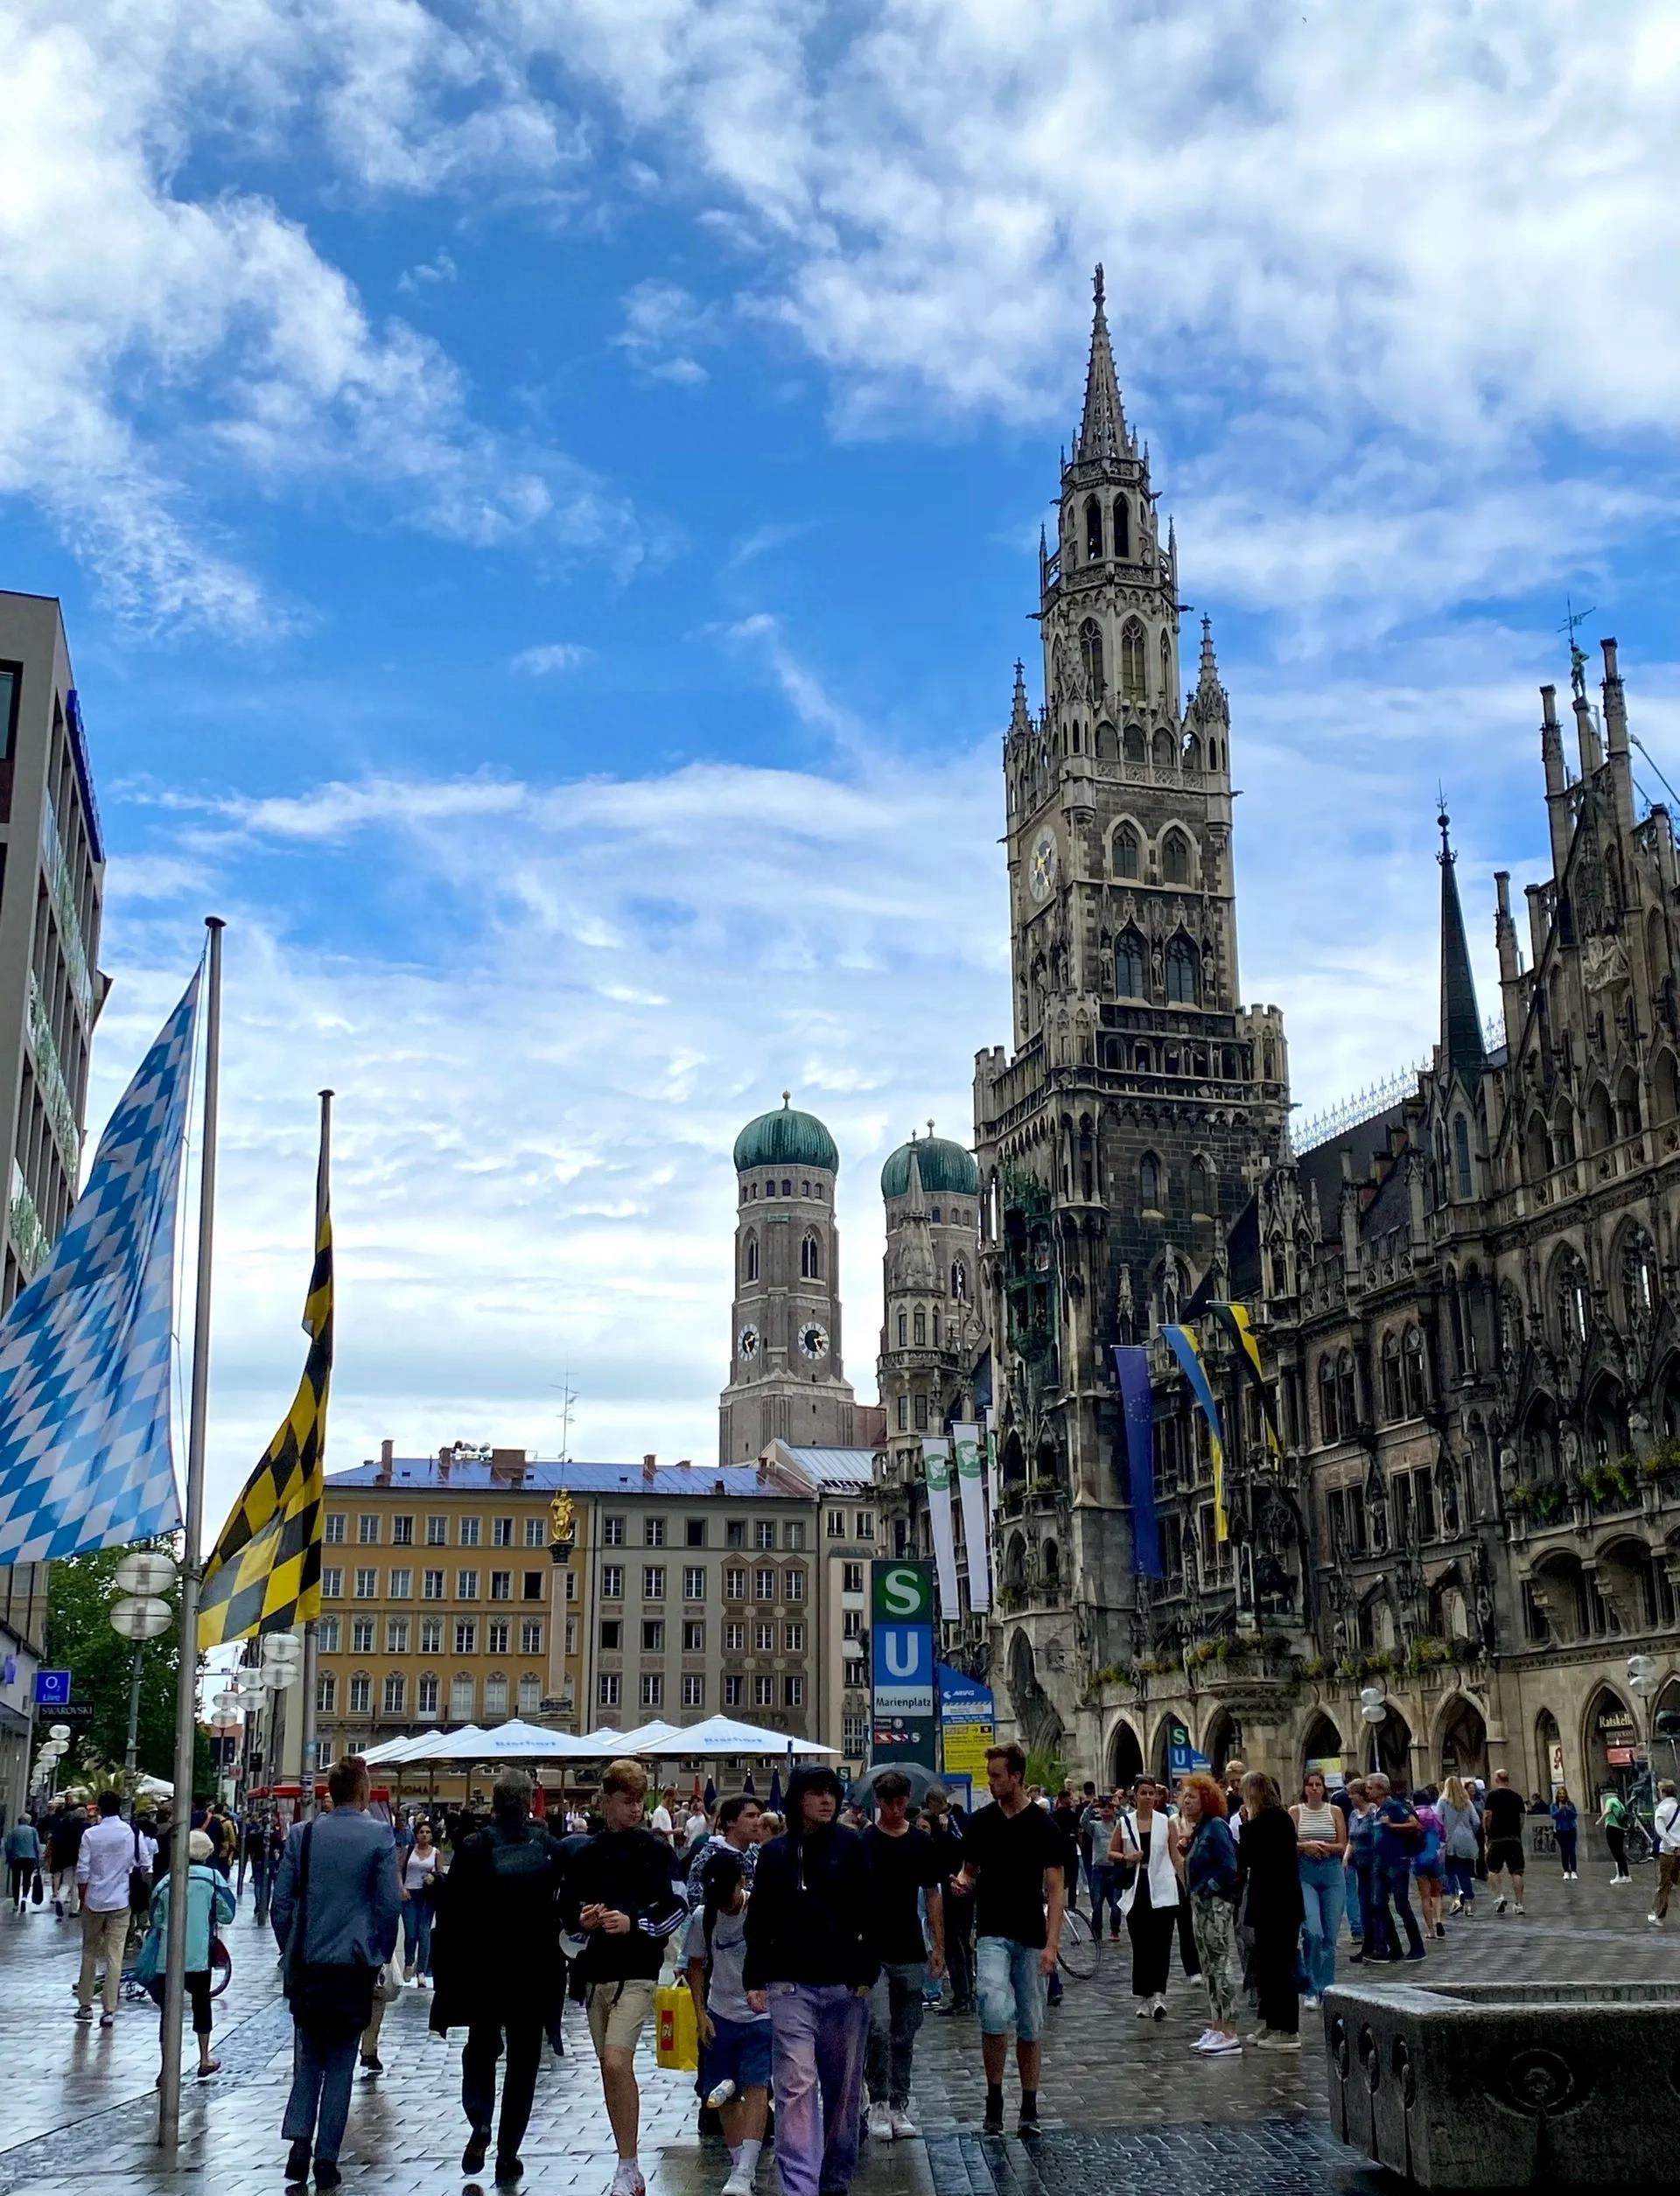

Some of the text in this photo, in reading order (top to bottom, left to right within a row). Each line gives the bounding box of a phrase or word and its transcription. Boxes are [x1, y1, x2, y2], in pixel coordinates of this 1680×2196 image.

[885, 1569, 921, 1615] S
[885, 1631, 919, 1677] U
[41, 1706, 93, 1715] SWAROVSKI
[875, 1697, 932, 1709] Marienplatz
[1173, 1728, 1186, 1745] S
[1174, 1750, 1186, 1766] U
[840, 1768, 849, 1780] S
